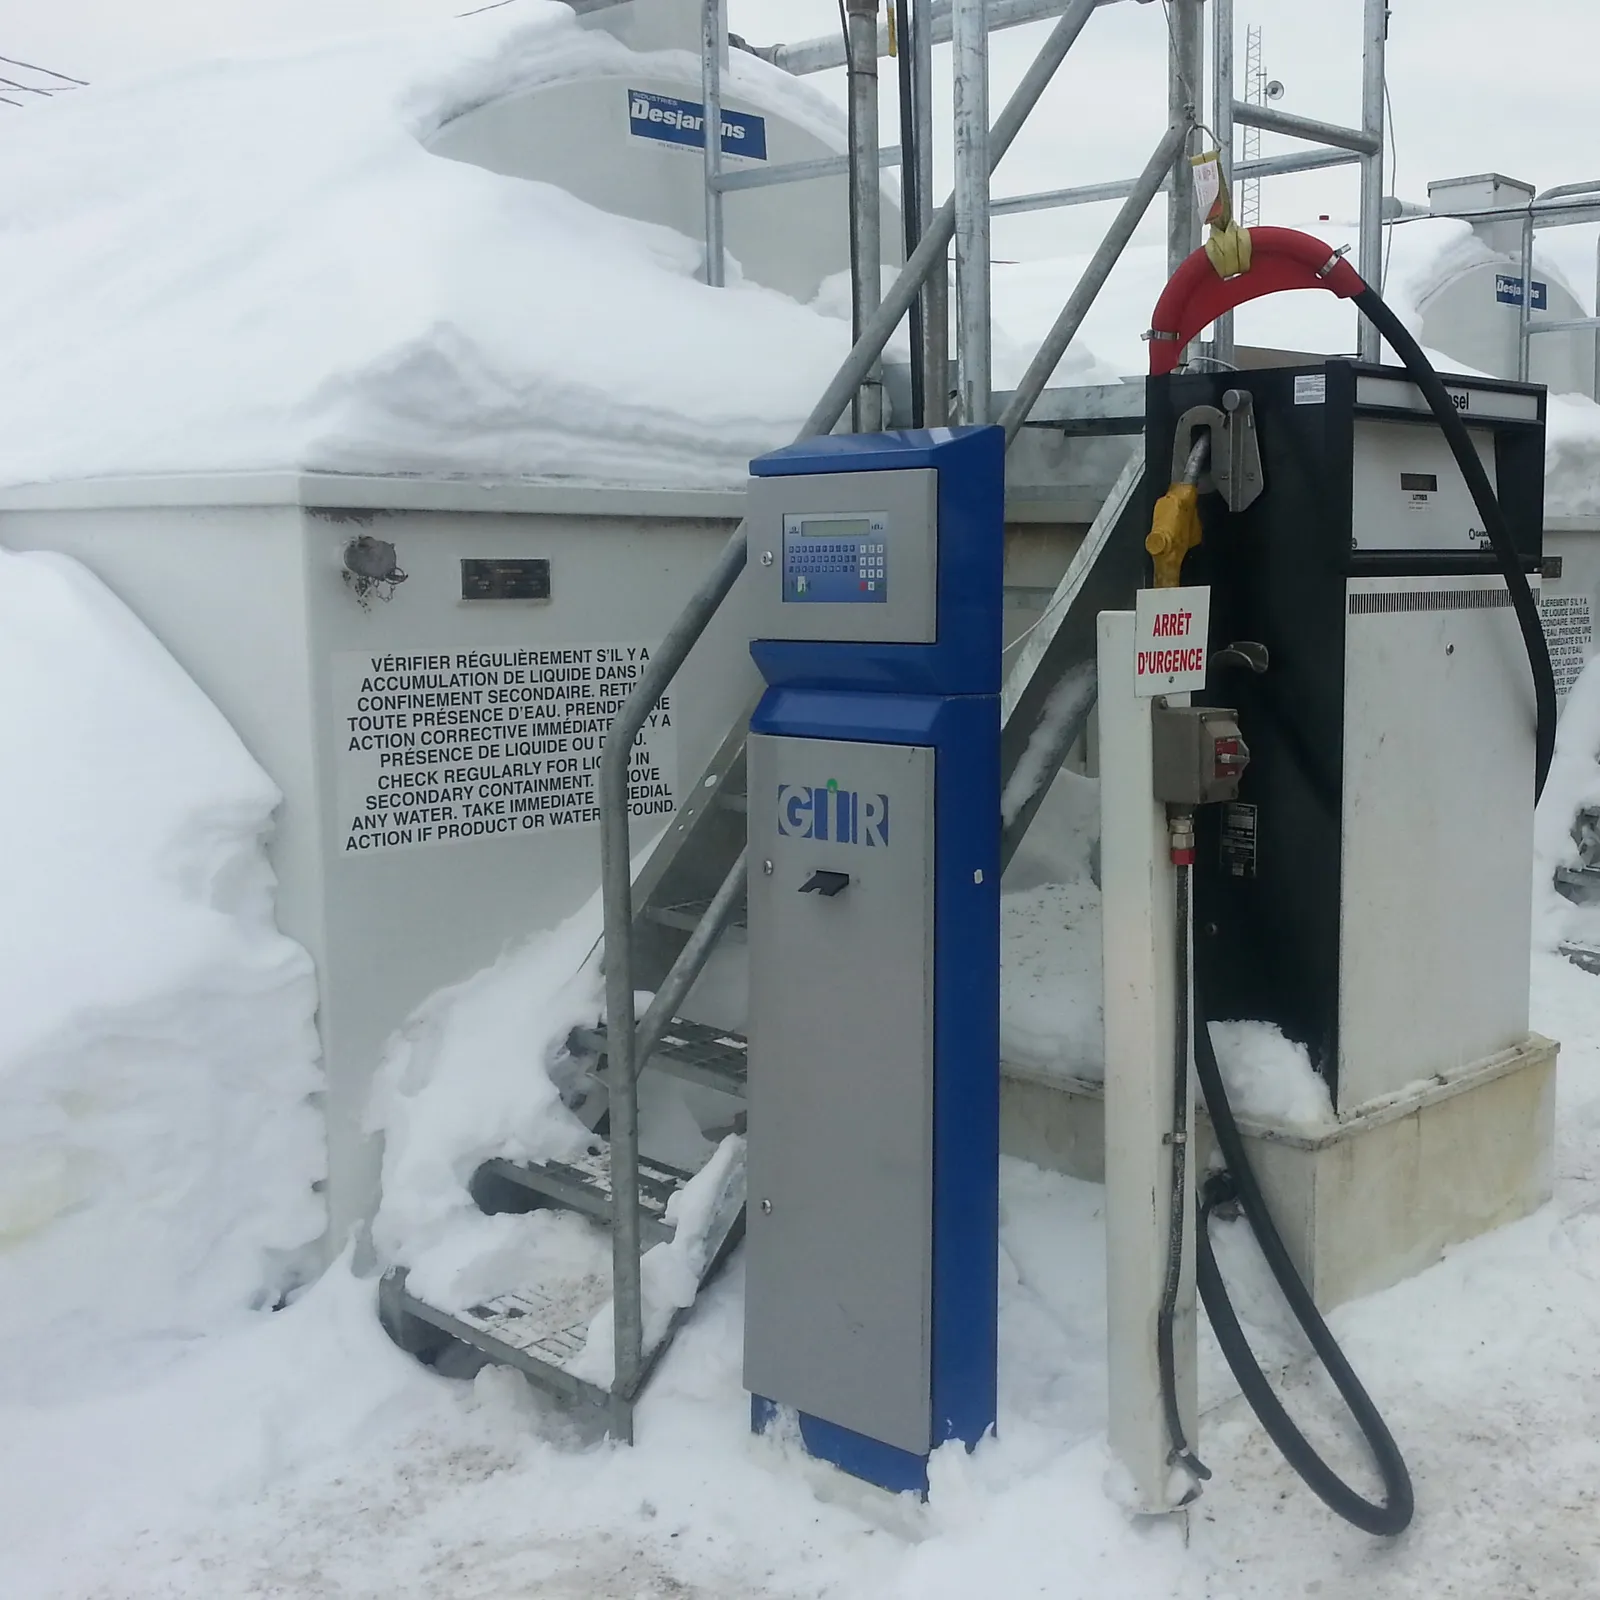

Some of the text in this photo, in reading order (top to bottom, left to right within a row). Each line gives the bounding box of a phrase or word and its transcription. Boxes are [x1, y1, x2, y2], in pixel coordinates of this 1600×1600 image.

[630, 98, 746, 139] Desjarns
[1452, 391, 1470, 410] sel
[1152, 607, 1192, 637] ARRÊT
[371, 647, 650, 673] VÉRIFIER RÉGULIÈREMENT S'IL Y A
[1137, 648, 1203, 675] D'URGENCE
[361, 671, 499, 693] ACCUMULATION
[503, 670, 525, 685] DE
[530, 667, 591, 684] LIQUIDE
[596, 665, 636, 680] DANS
[357, 682, 637, 712] CONFINEMENT SECONDAIRE. RETI
[347, 713, 407, 732] TOUTE
[412, 707, 504, 728] PRÉSENCE
[508, 704, 561, 721] D'EAU.
[565, 700, 625, 717] PREND
[348, 732, 416, 751] ACTION
[420, 724, 528, 746] CORRECTIVE
[649, 714, 658, 728] Y
[661, 714, 672, 727] A
[380, 746, 473, 768] PRÉSENCE
[478, 744, 500, 760] DE
[505, 738, 568, 757] LIQUIDE
[572, 736, 594, 751] OU
[378, 770, 439, 790] CHECK
[444, 761, 542, 784] REGULARLY
[546, 758, 578, 774] FOR
[635, 752, 650, 766] IN
[365, 785, 474, 810] SECONDARY
[478, 774, 595, 799] CONTAINMENT.
[351, 813, 388, 831] ANY
[393, 806, 458, 826] WATER.
[462, 800, 506, 818] TAKE
[510, 791, 595, 813] IMMEDIATE
[346, 829, 413, 851] ACTION
[417, 827, 433, 843] IF
[437, 817, 518, 840] PRODUCT
[522, 814, 545, 829] OR
[550, 808, 600, 826] WATER
